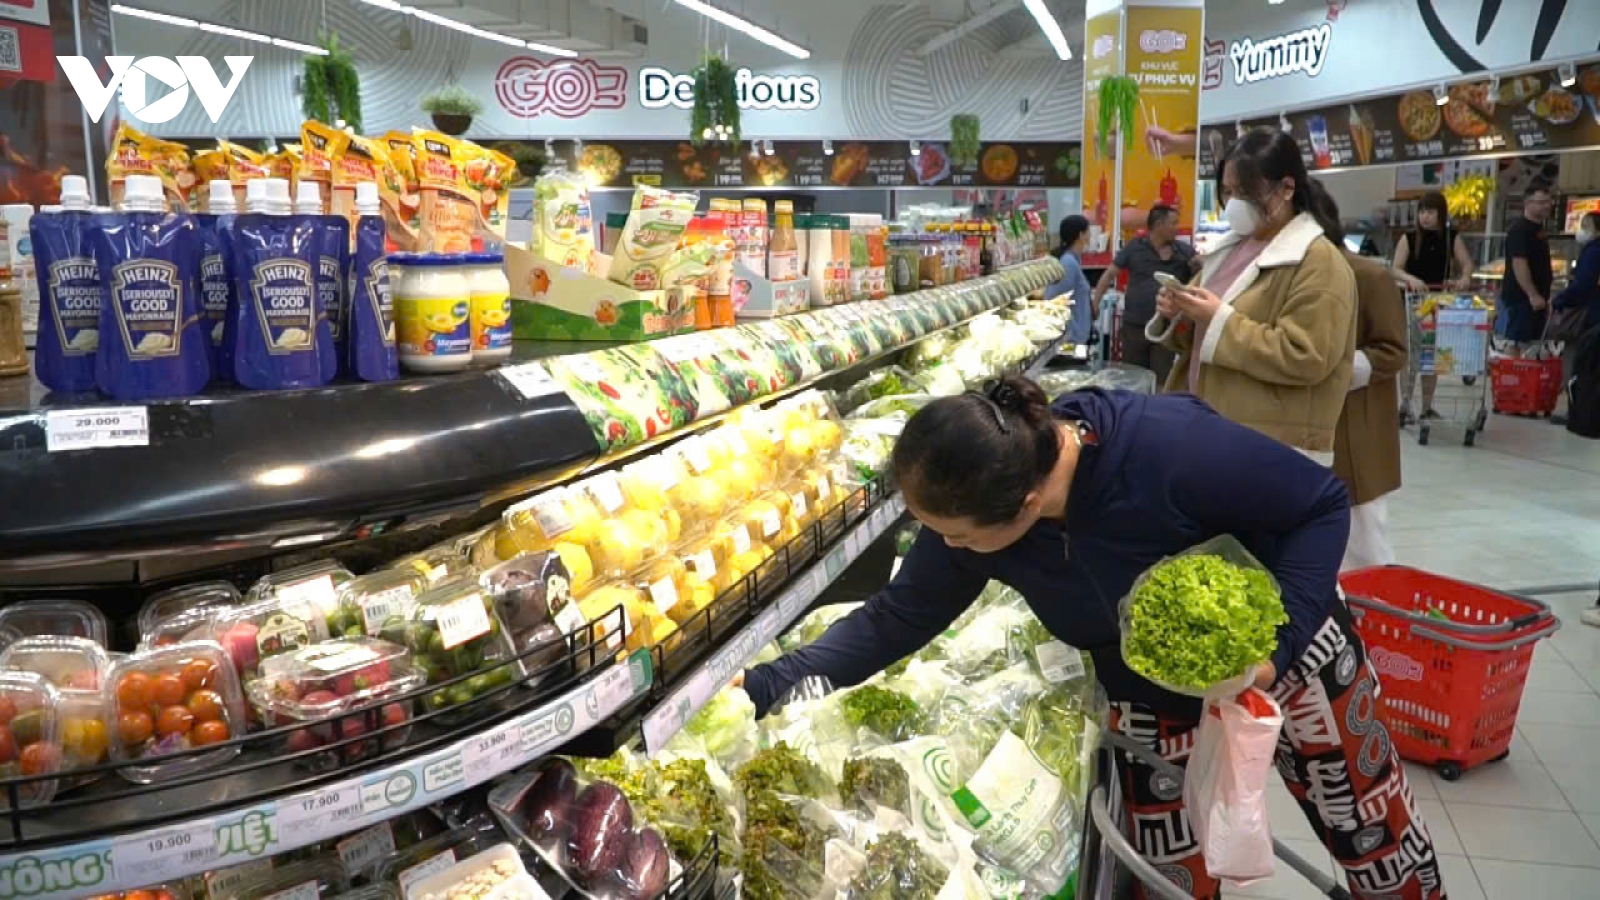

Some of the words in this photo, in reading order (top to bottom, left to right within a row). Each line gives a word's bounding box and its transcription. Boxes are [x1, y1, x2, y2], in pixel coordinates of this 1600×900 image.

[1231, 26, 1330, 83] Yummy
[1141, 61, 1159, 70] KHU
[643, 68, 818, 106] Deious
[1145, 73, 1177, 86] PHỤC
[1179, 73, 1196, 88] VỤ
[123, 269, 170, 282] HEINZ
[204, 264, 224, 277] HEI
[265, 267, 306, 281] HEINZ
[130, 300, 169, 311] GOOD
[270, 297, 305, 309] GOOD
[302, 792, 341, 811] 17.900
[148, 834, 192, 851] 19.900
